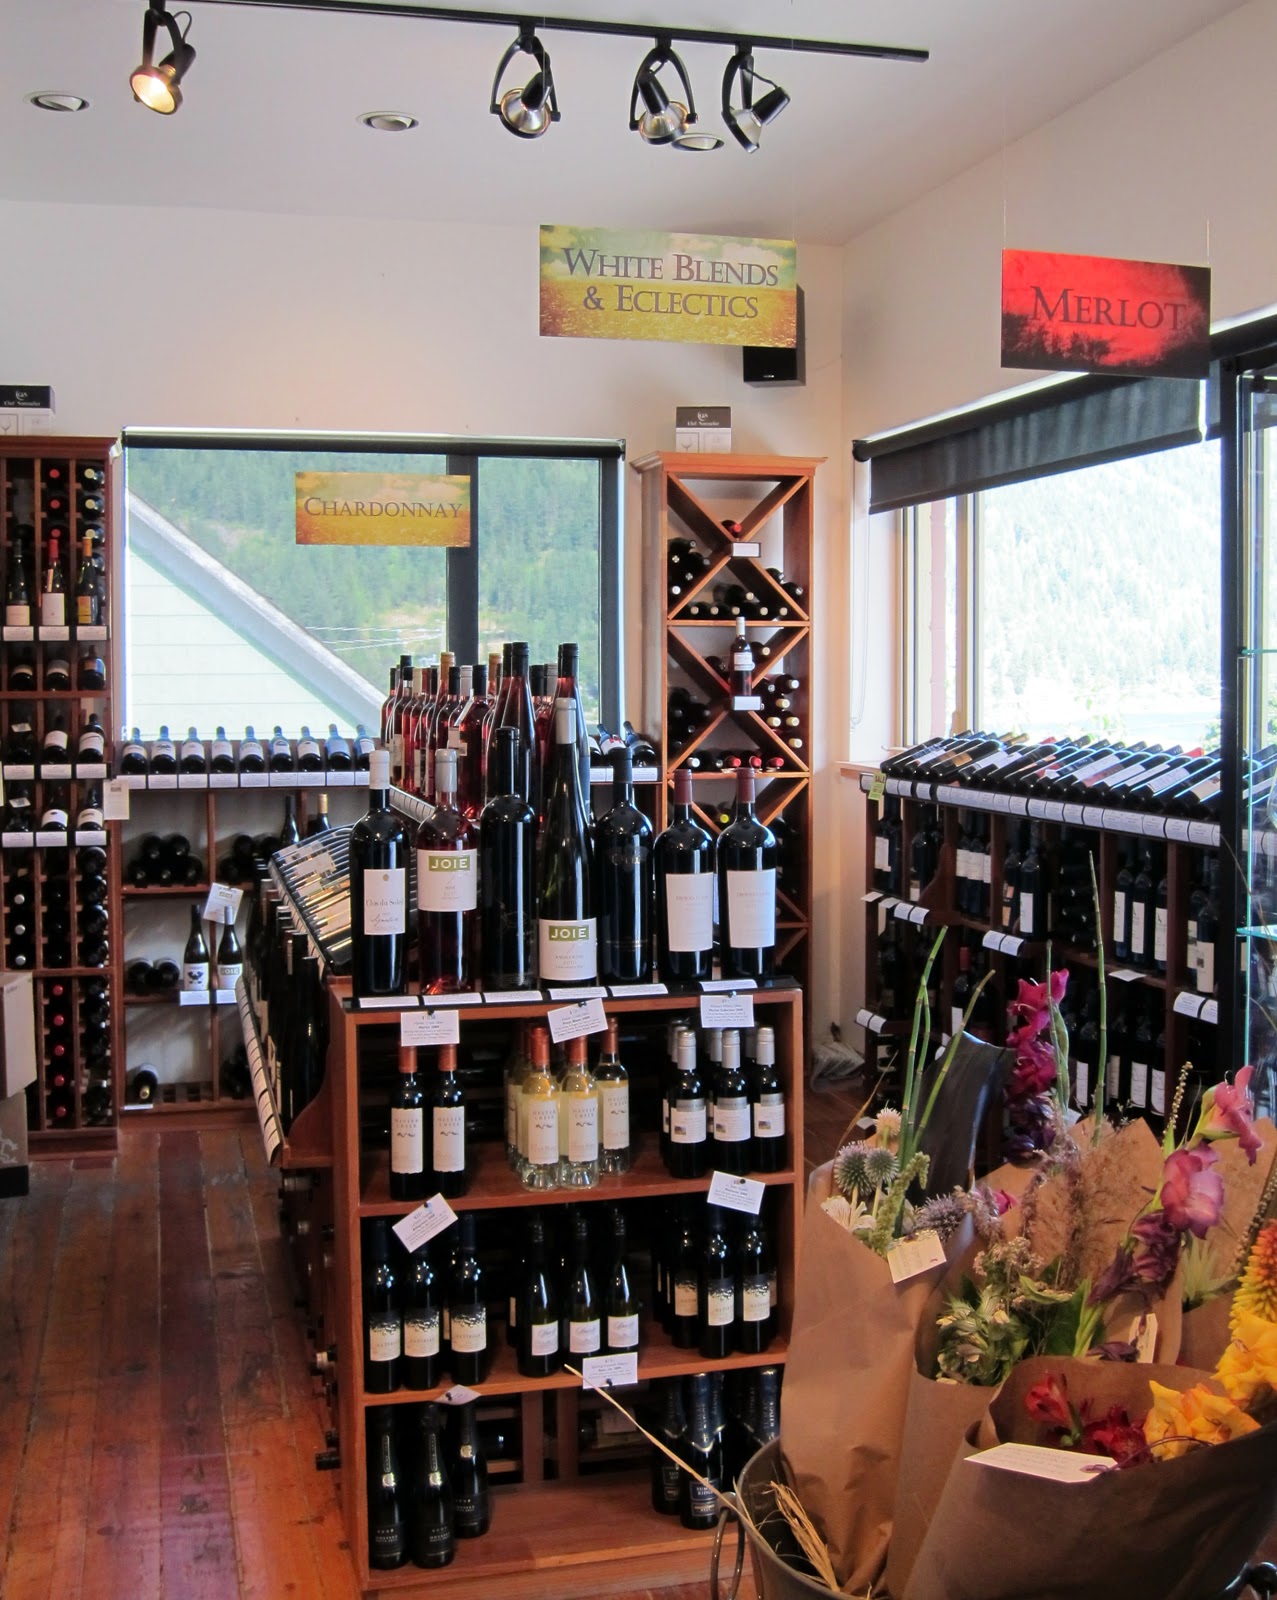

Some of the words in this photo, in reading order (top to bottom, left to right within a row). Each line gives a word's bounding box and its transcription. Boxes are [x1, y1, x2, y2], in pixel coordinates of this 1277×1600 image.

[561, 248, 663, 279] WHITE
[672, 254, 778, 286] BLENDS
[583, 285, 604, 310] &
[614, 284, 758, 318] ECLECTICS
[1030, 285, 1187, 330] MERLOT
[304, 497, 463, 518] CHARDONNAY
[431, 858, 468, 869] JOIE
[551, 928, 587, 939] JOIE
